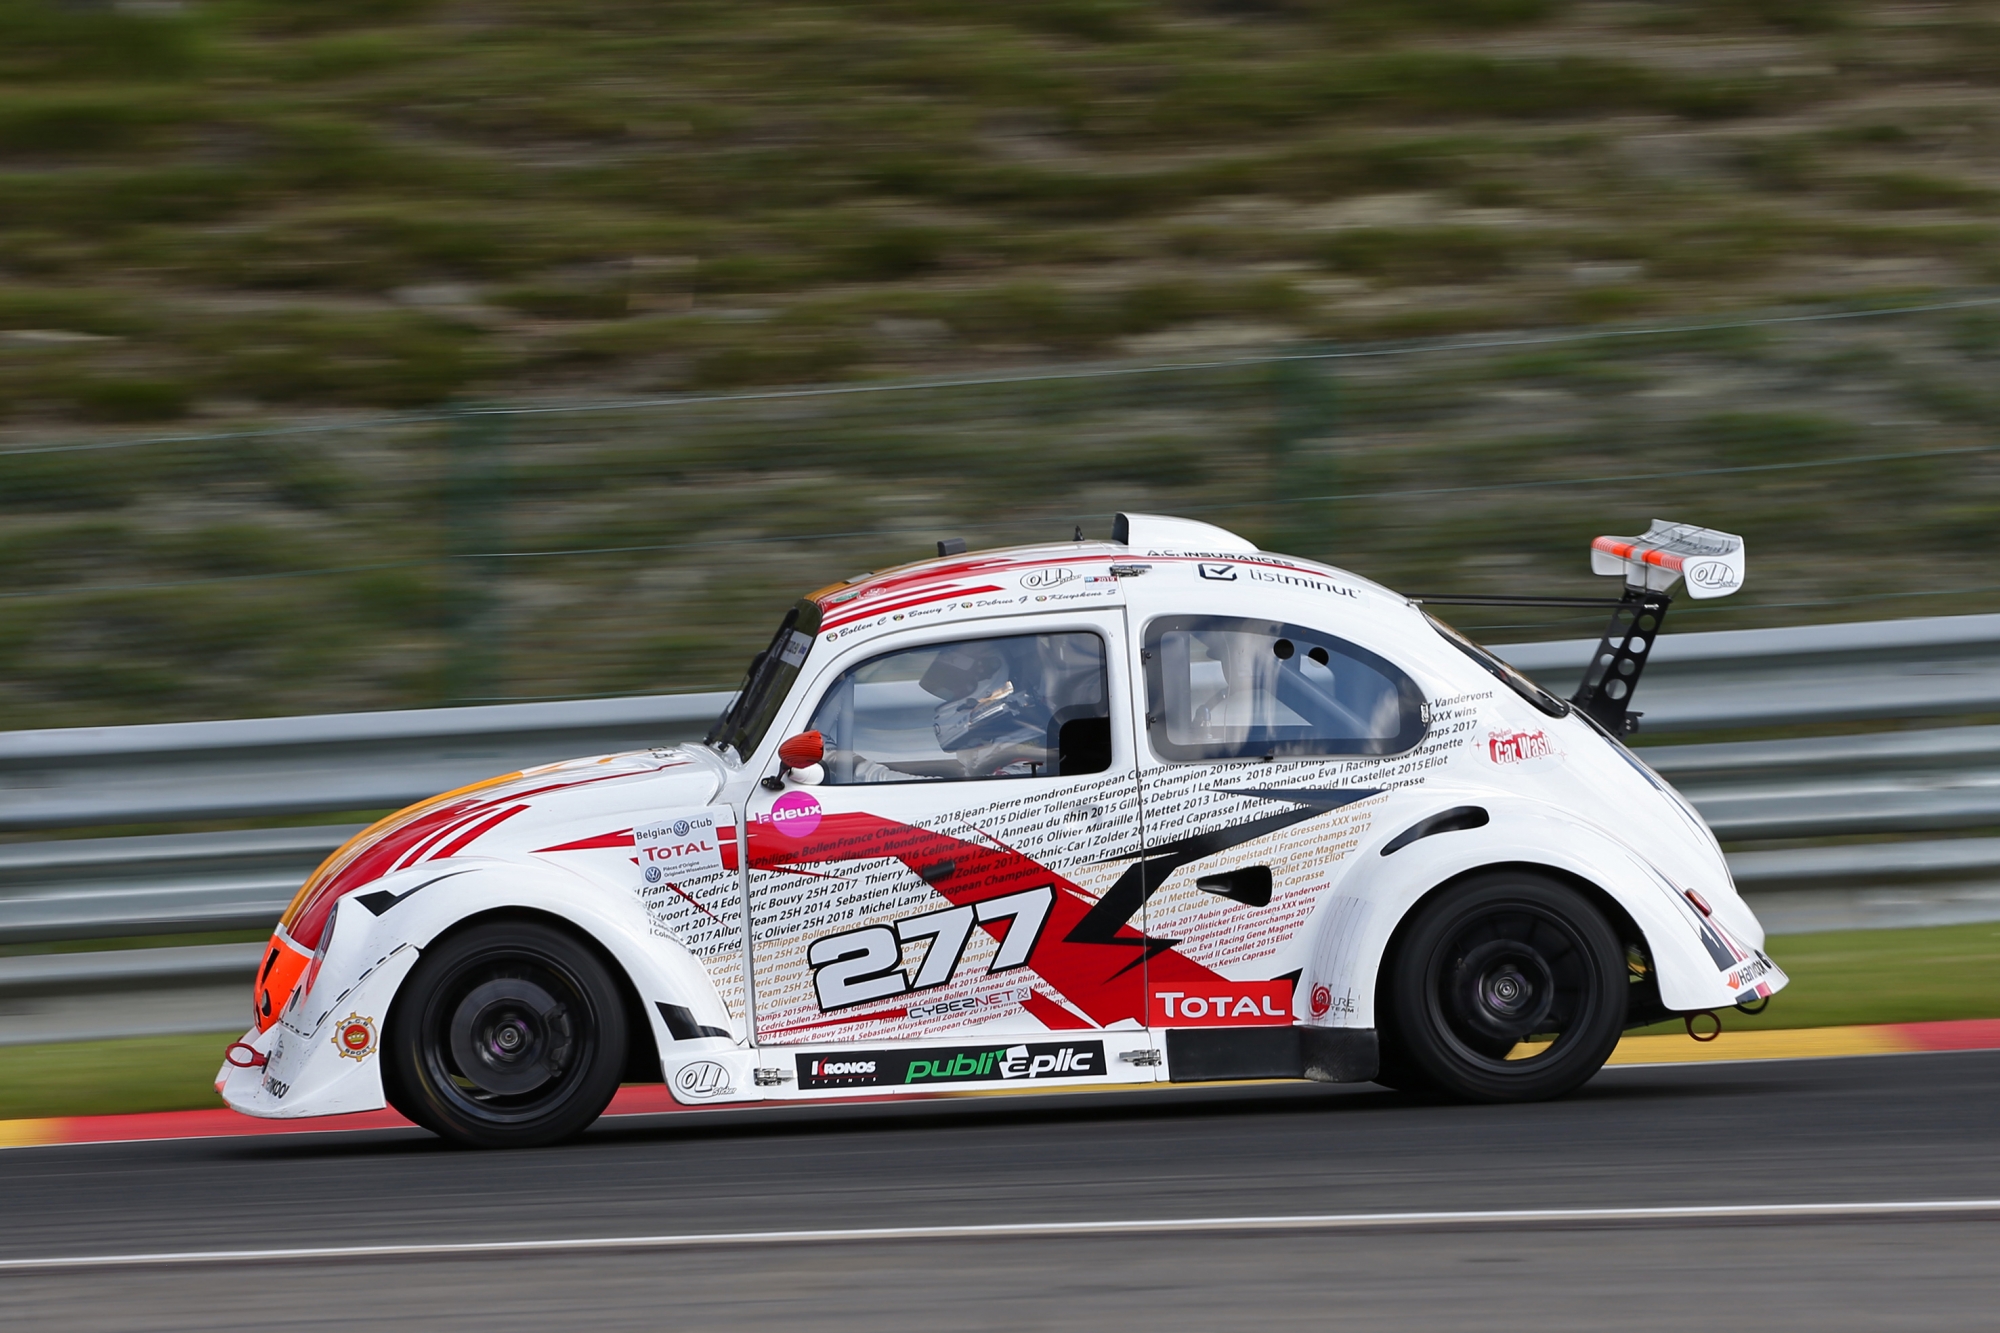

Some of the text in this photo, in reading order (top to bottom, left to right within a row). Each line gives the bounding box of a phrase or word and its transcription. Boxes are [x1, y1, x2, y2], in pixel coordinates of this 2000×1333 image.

[1183, 551, 1295, 567] INSURANCES
[839, 624, 873, 638] Bollen
[908, 608, 943, 618] Bouvy
[976, 598, 1014, 608] Debrus
[1435, 688, 1493, 708] Vandervorst
[1430, 706, 1477, 724] XXX wins
[1452, 719, 1477, 734] 2017
[1412, 738, 1463, 757] Magnette
[1491, 739, 1517, 765] Car
[1517, 733, 1554, 760] Wash
[1318, 767, 1336, 778] Eva
[1351, 766, 1396, 784] Castellet
[941, 769, 1207, 839] Mettet 2015 Champion
[636, 818, 713, 840] Belgian Club
[770, 875, 820, 894] mondron
[833, 857, 890, 880] Zandvoort
[892, 848, 919, 865] 2016
[922, 842, 955, 857] Celine
[958, 834, 992, 849] Bollen
[1001, 822, 1043, 839] Anneau
[1045, 817, 1060, 828] du
[1063, 811, 1088, 825] Rhin
[1091, 803, 1117, 818] 2015
[1151, 787, 1189, 803] Debrus
[1213, 775, 1241, 789] Mans
[1246, 766, 1272, 781] 2018
[1275, 760, 1298, 774] Paul
[875, 819, 931, 838] Champion
[1016, 833, 1043, 849] 2016
[1047, 827, 1083, 841] Olivier
[1144, 801, 1181, 820] Mettet
[1183, 794, 1210, 810] 2013
[1272, 811, 1371, 841] Eric Gressens XXX wins
[642, 840, 714, 862] TOTAL
[955, 863, 991, 879] Zolder
[993, 853, 1020, 870] 2013
[1023, 841, 1085, 862] Technic-Car
[1093, 830, 1129, 846] Zolder
[1160, 814, 1184, 830] Fred
[1187, 805, 1234, 823] Caprasse
[1173, 822, 1371, 878] 2018 Paul Dingelstadt Francorchamps 2017
[1290, 839, 1358, 860] Gene Magnette
[795, 858, 820, 874] 2016
[1074, 859, 1120, 876] Champion
[641, 871, 724, 897] Francorchamps
[765, 831, 1184, 939] Olivier 25H 2018 Michel Lamy European Champion Olivier
[1284, 869, 1325, 886] Caprasse
[696, 884, 729, 899] Cedric
[768, 894, 804, 909] Bouvy
[806, 886, 828, 901] 25H
[831, 878, 858, 895] 2017
[865, 867, 906, 886] Thierry
[1169, 887, 1199, 903] Mettet
[1284, 880, 1331, 899] Vandervorst
[751, 888, 889, 927] Team 25H 2014 Sebastien
[863, 909, 910, 926] Champion
[1153, 898, 1209, 918] 2014 Claude
[1170, 896, 1316, 939] Toupy Olisticker Eric Gressens XXX wins
[1156, 918, 1177, 931] Adria
[1178, 912, 1199, 926] 2017
[1187, 905, 1316, 944] Dingelstadt Francorchamps 2017
[686, 929, 712, 945] 2017
[1198, 919, 1304, 951] Eva Racing Gene Magnette
[774, 946, 792, 958] 25H
[807, 883, 1058, 1013] 277
[1190, 940, 1255, 962] David Castellet
[1218, 947, 1276, 967] Kevin Caprasse
[712, 961, 741, 975] Cedric
[774, 969, 803, 983] Bouvy
[757, 981, 801, 999] Team 25H
[943, 972, 1035, 1000] Bollen Anneau Rhin
[770, 995, 801, 1008] Olivier
[1155, 991, 1286, 1018] TOTAL
[760, 1014, 811, 1031] Cedric bollen
[811, 1028, 836, 1042] Bouvy
[837, 1023, 854, 1035] 25H
[855, 1018, 875, 1031] 2017
[858, 1024, 896, 1039] Sebastien
[902, 1011, 1002, 1040] Lamy European Champion
[811, 1057, 877, 1076] KRONOS
